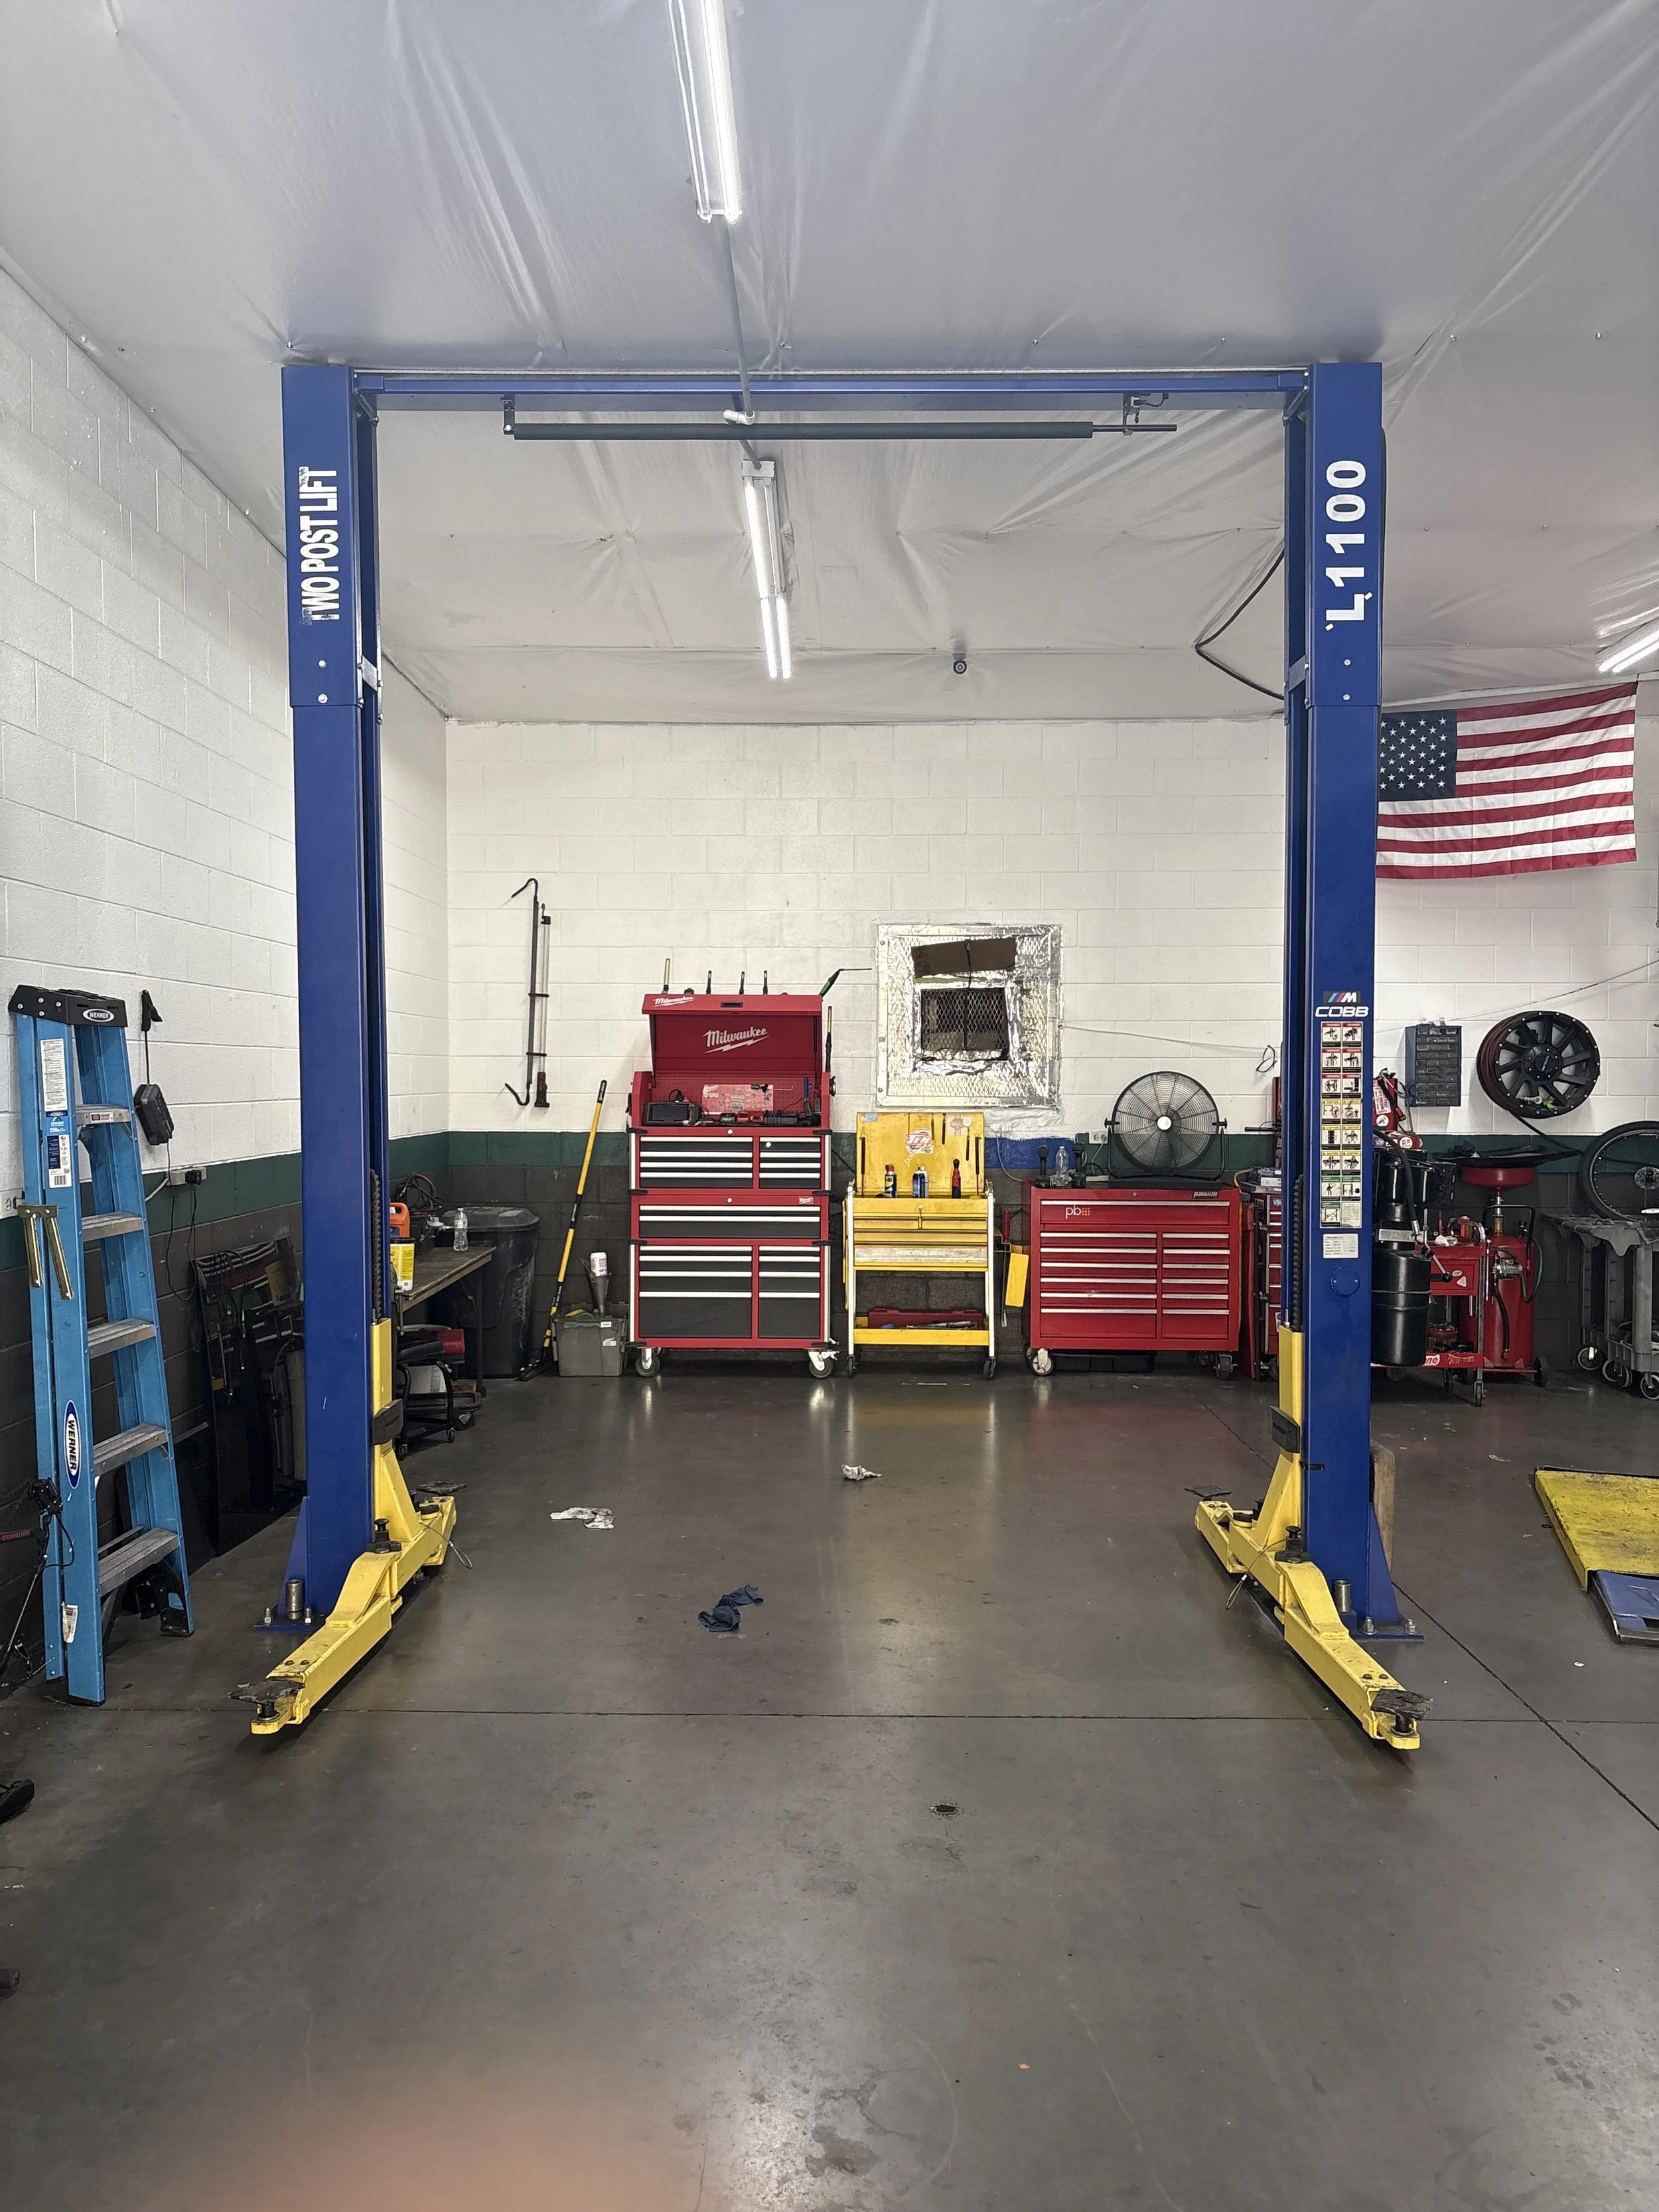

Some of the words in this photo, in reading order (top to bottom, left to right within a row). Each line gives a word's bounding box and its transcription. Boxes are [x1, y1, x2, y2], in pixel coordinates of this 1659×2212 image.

[299, 466, 337, 512] LIFT
[300, 515, 339, 573] POST
[653, 996, 694, 1005] Milwaukee
[1315, 1006, 1369, 1017] COBB
[703, 1026, 768, 1048] Milwaukee
[1065, 1205, 1082, 1220] pb
[68, 1420, 77, 1471] WERNER
